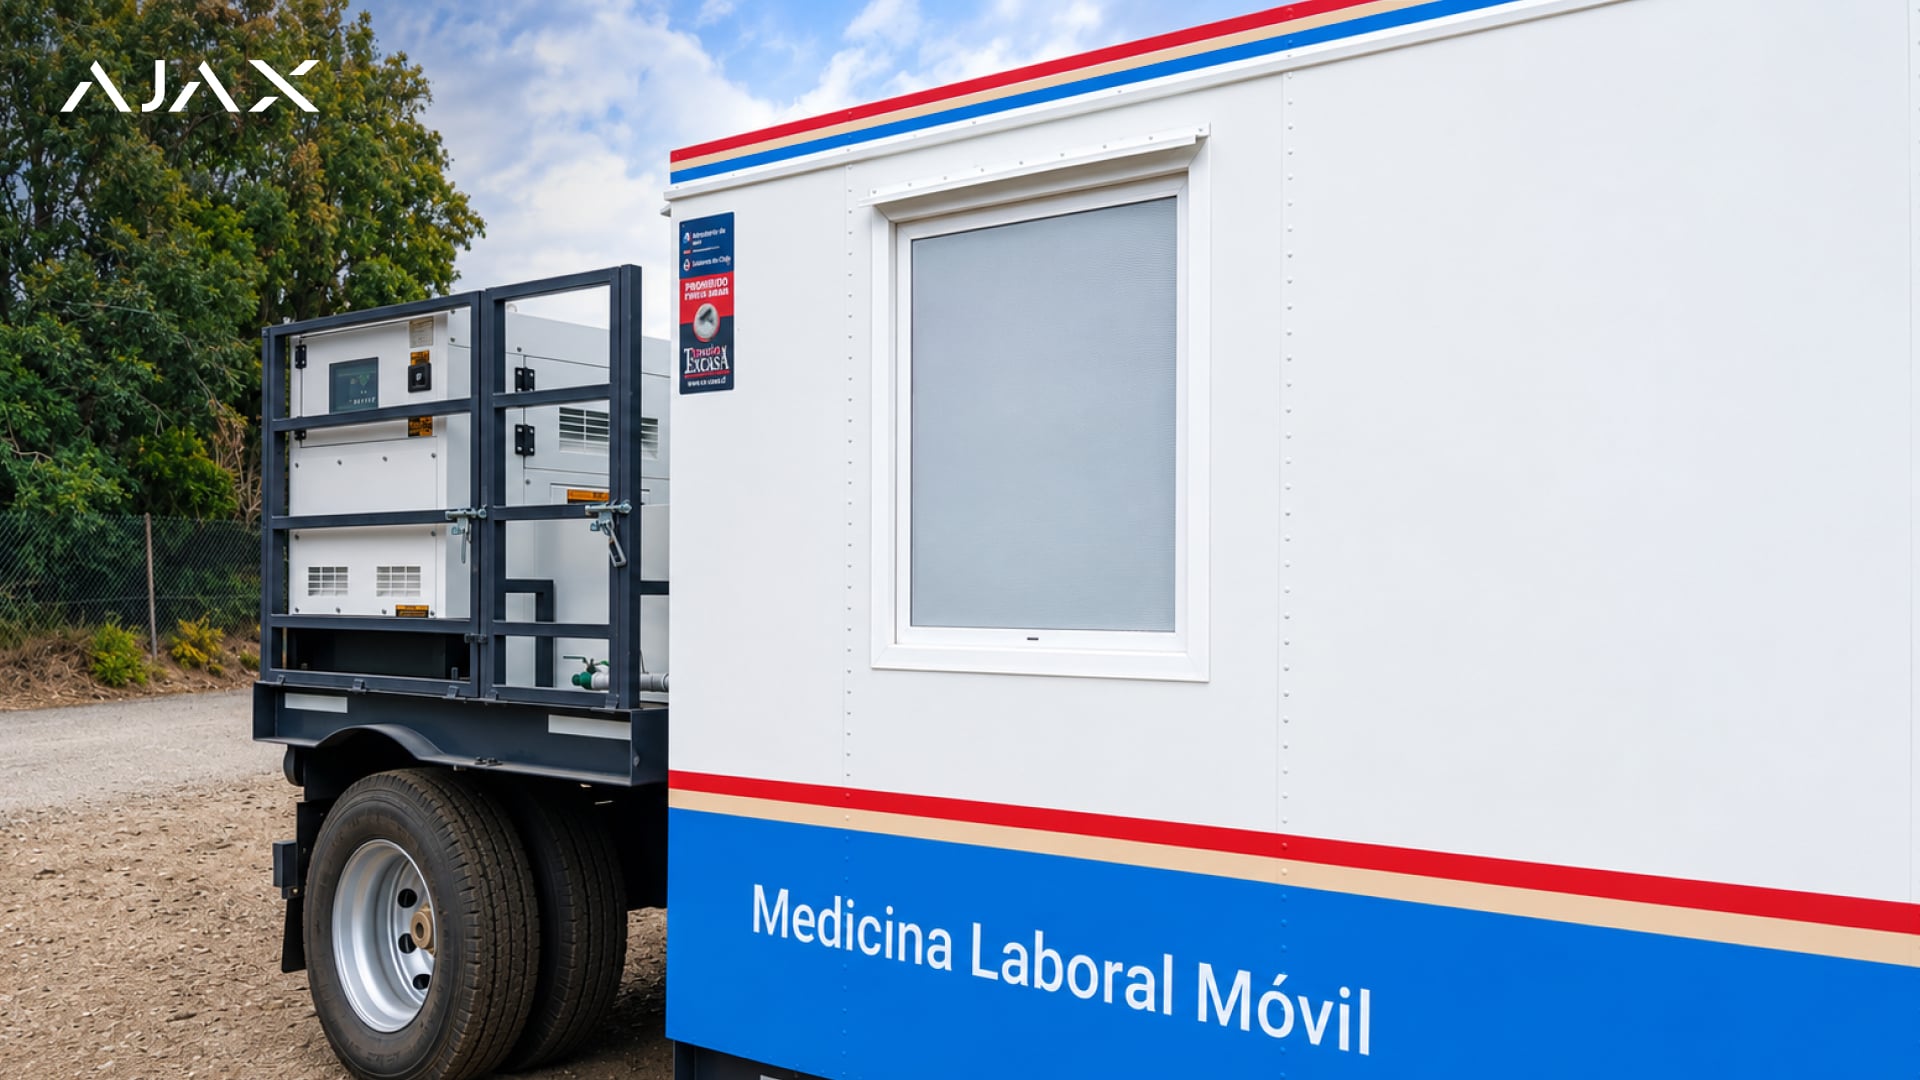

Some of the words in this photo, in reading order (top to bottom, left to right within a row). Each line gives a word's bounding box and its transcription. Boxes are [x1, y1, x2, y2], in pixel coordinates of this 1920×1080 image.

[753, 884, 953, 972] Medicina
[972, 922, 1173, 1016] Laboral
[1198, 962, 1371, 1056] Móvil
